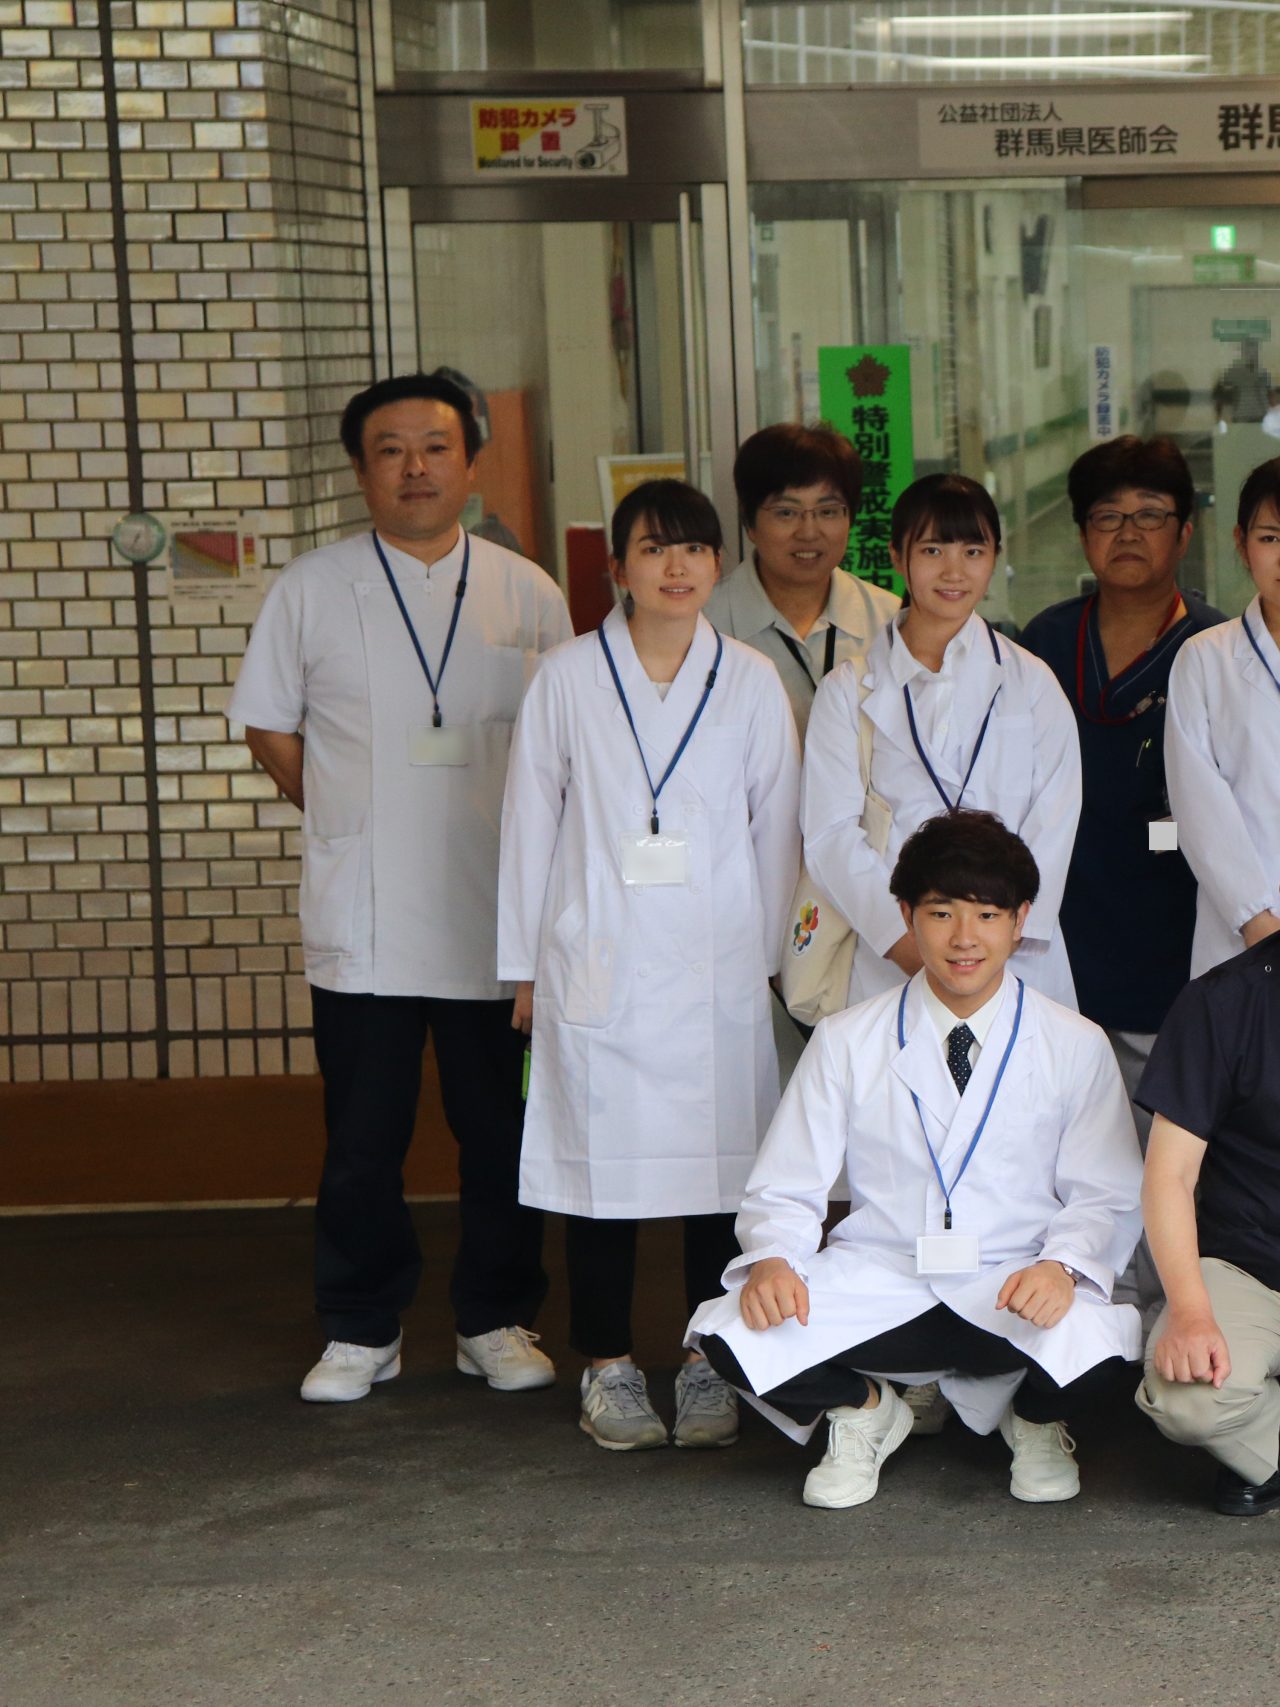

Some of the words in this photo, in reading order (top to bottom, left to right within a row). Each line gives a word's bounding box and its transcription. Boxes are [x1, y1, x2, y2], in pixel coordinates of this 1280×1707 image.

[479, 108, 576, 129] 防犯カメラ
[938, 100, 1063, 124] 公益社団法人
[995, 125, 1179, 157] 群馬県医師会
